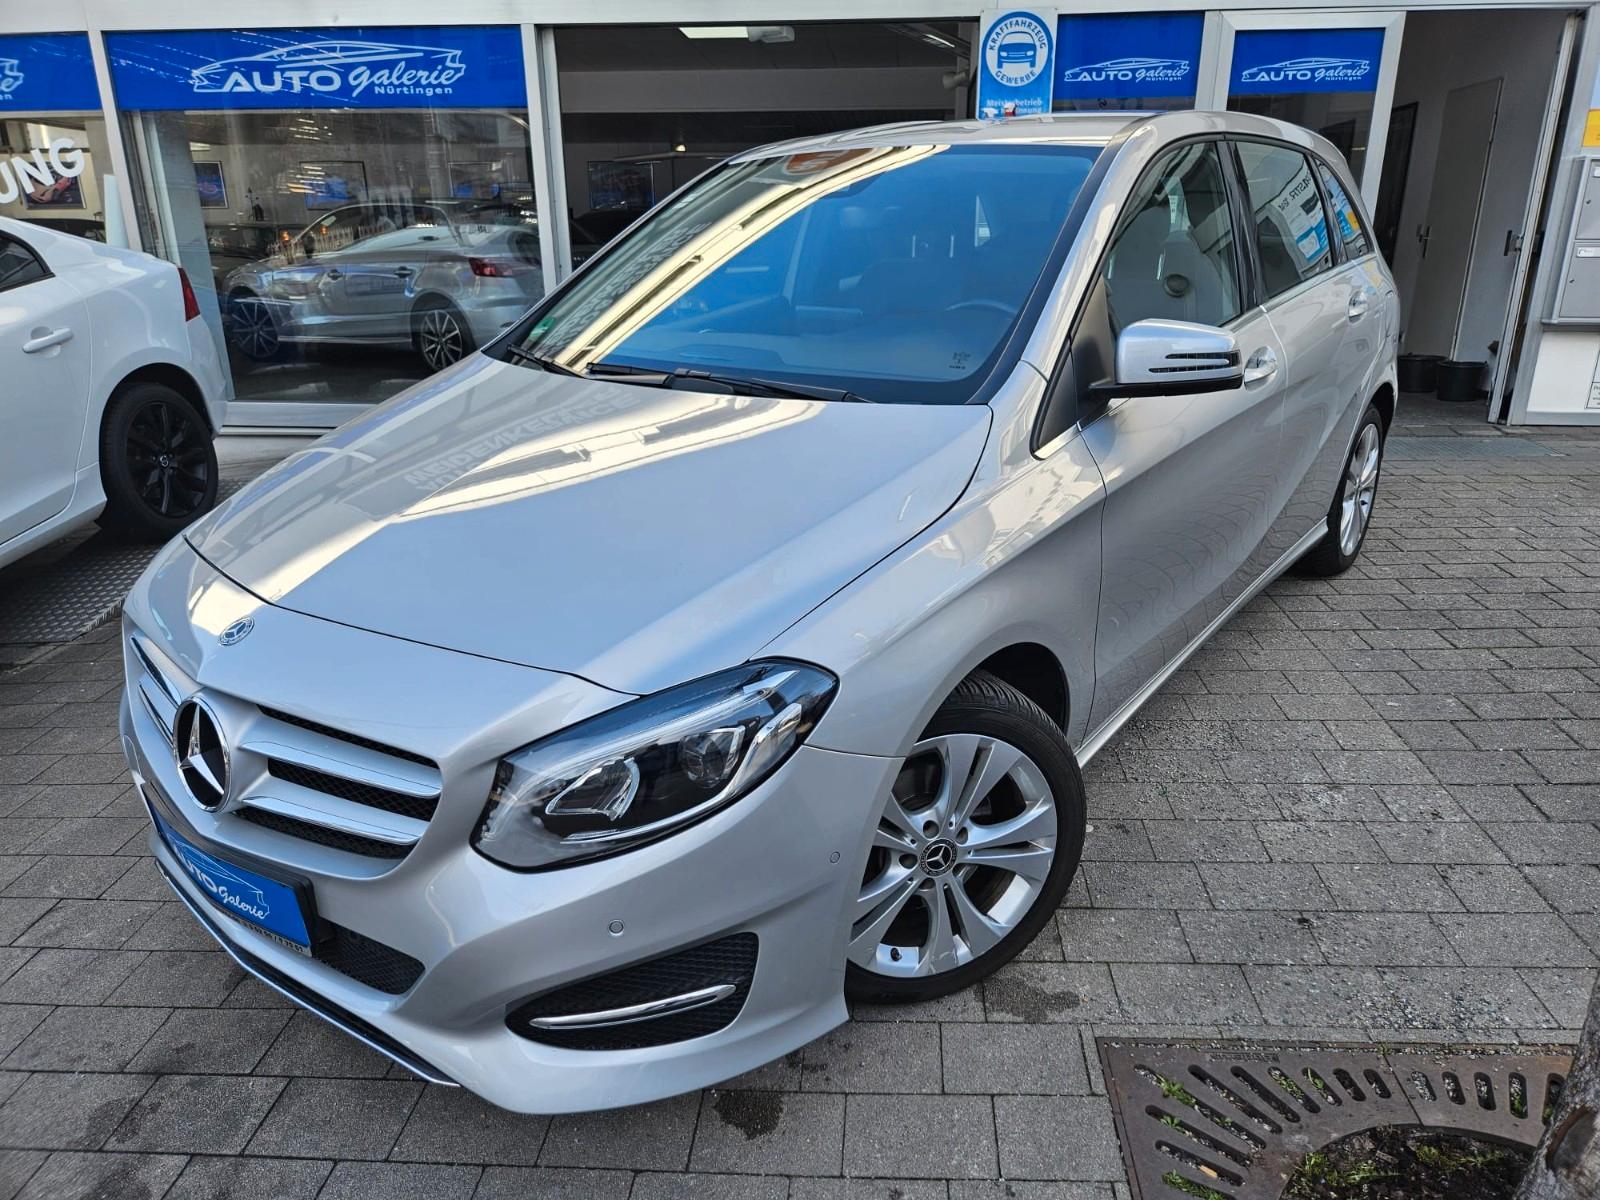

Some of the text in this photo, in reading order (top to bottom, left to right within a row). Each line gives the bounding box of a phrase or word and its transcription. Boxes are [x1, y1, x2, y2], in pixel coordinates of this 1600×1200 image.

[988, 19, 1047, 51] KRAFTFAHRZEUG
[222, 61, 458, 98] AUTO galerie
[995, 69, 1038, 84] GEWERBE
[1078, 66, 1187, 84] AUTO galerie
[1255, 66, 1367, 83] AUTO galerie
[374, 84, 453, 96] Nürtingen
